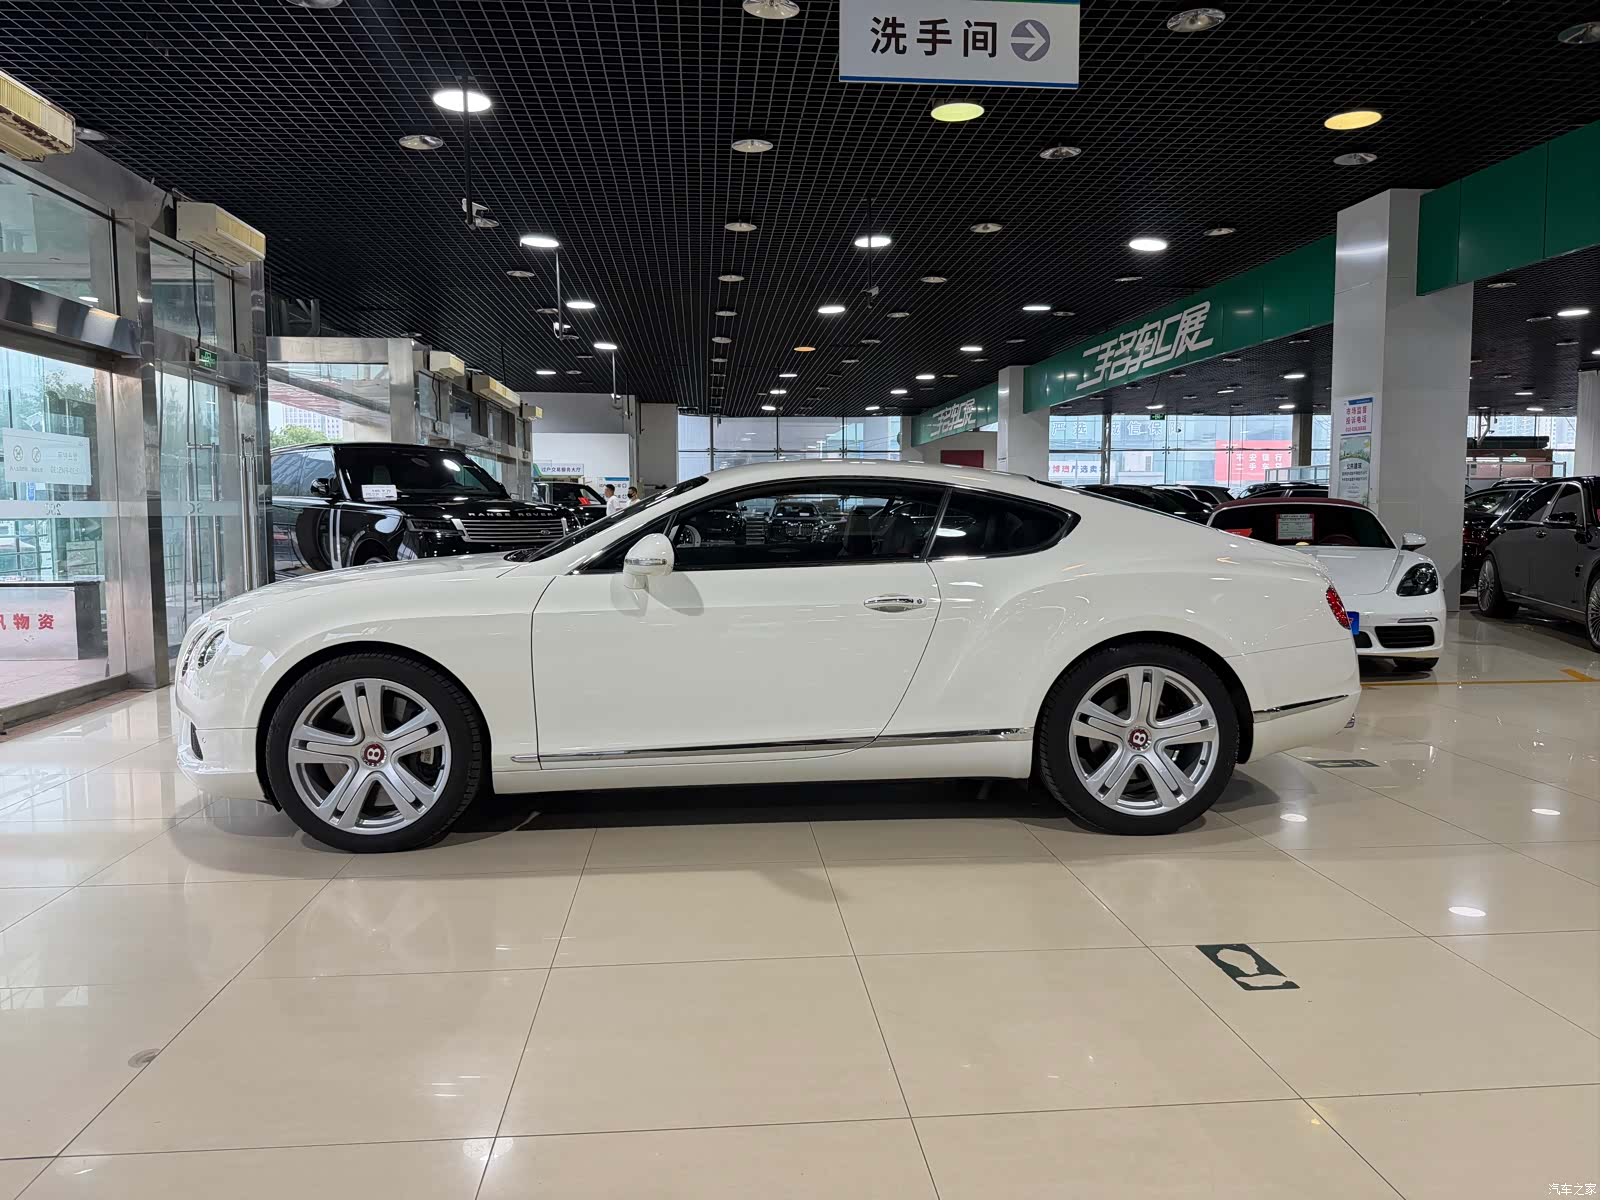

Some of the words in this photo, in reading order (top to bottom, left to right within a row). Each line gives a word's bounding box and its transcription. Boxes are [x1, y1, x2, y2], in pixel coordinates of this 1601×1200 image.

[870, 16, 998, 58] 洗手间
[1076, 301, 1214, 391] 二手名车汇展
